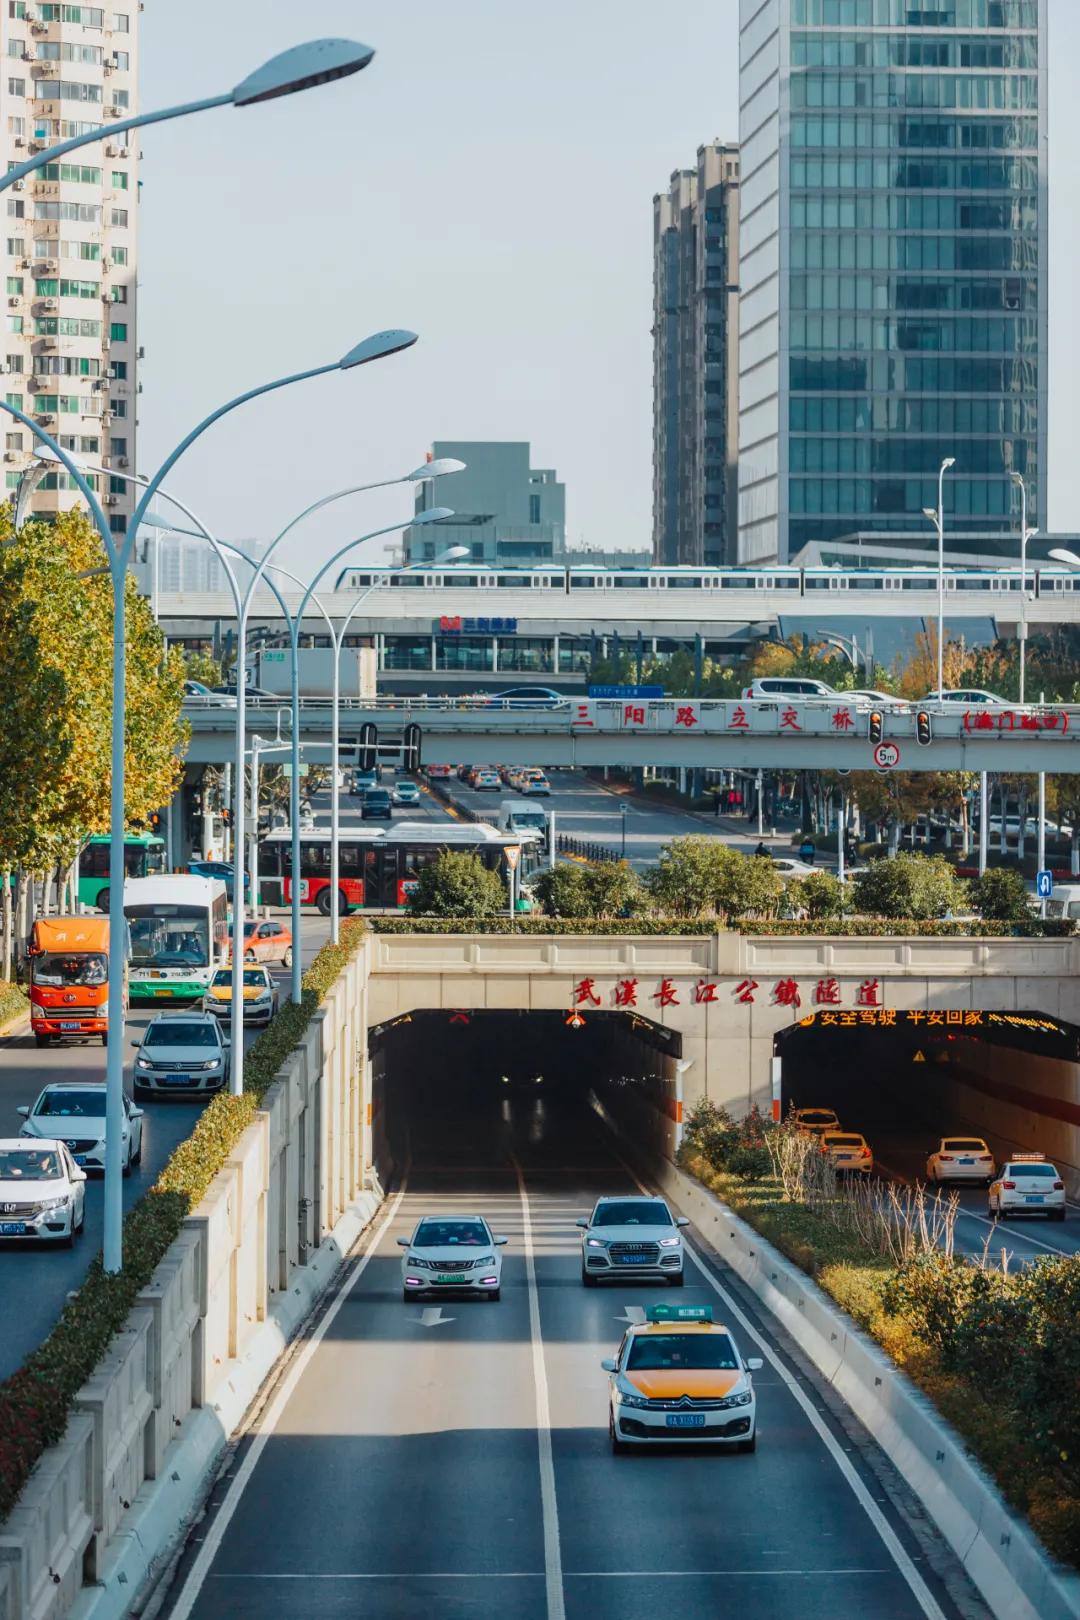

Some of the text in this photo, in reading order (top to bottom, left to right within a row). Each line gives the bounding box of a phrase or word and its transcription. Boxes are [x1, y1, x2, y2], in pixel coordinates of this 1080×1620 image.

[572, 704, 855, 731] 三阳路立交桥
[879, 749, 895, 761] 5m
[574, 977, 883, 1008] 武漢長江公鐵隧道
[821, 1009, 897, 1026] 安全驾驶
[906, 1009, 983, 1025] 平安回家
